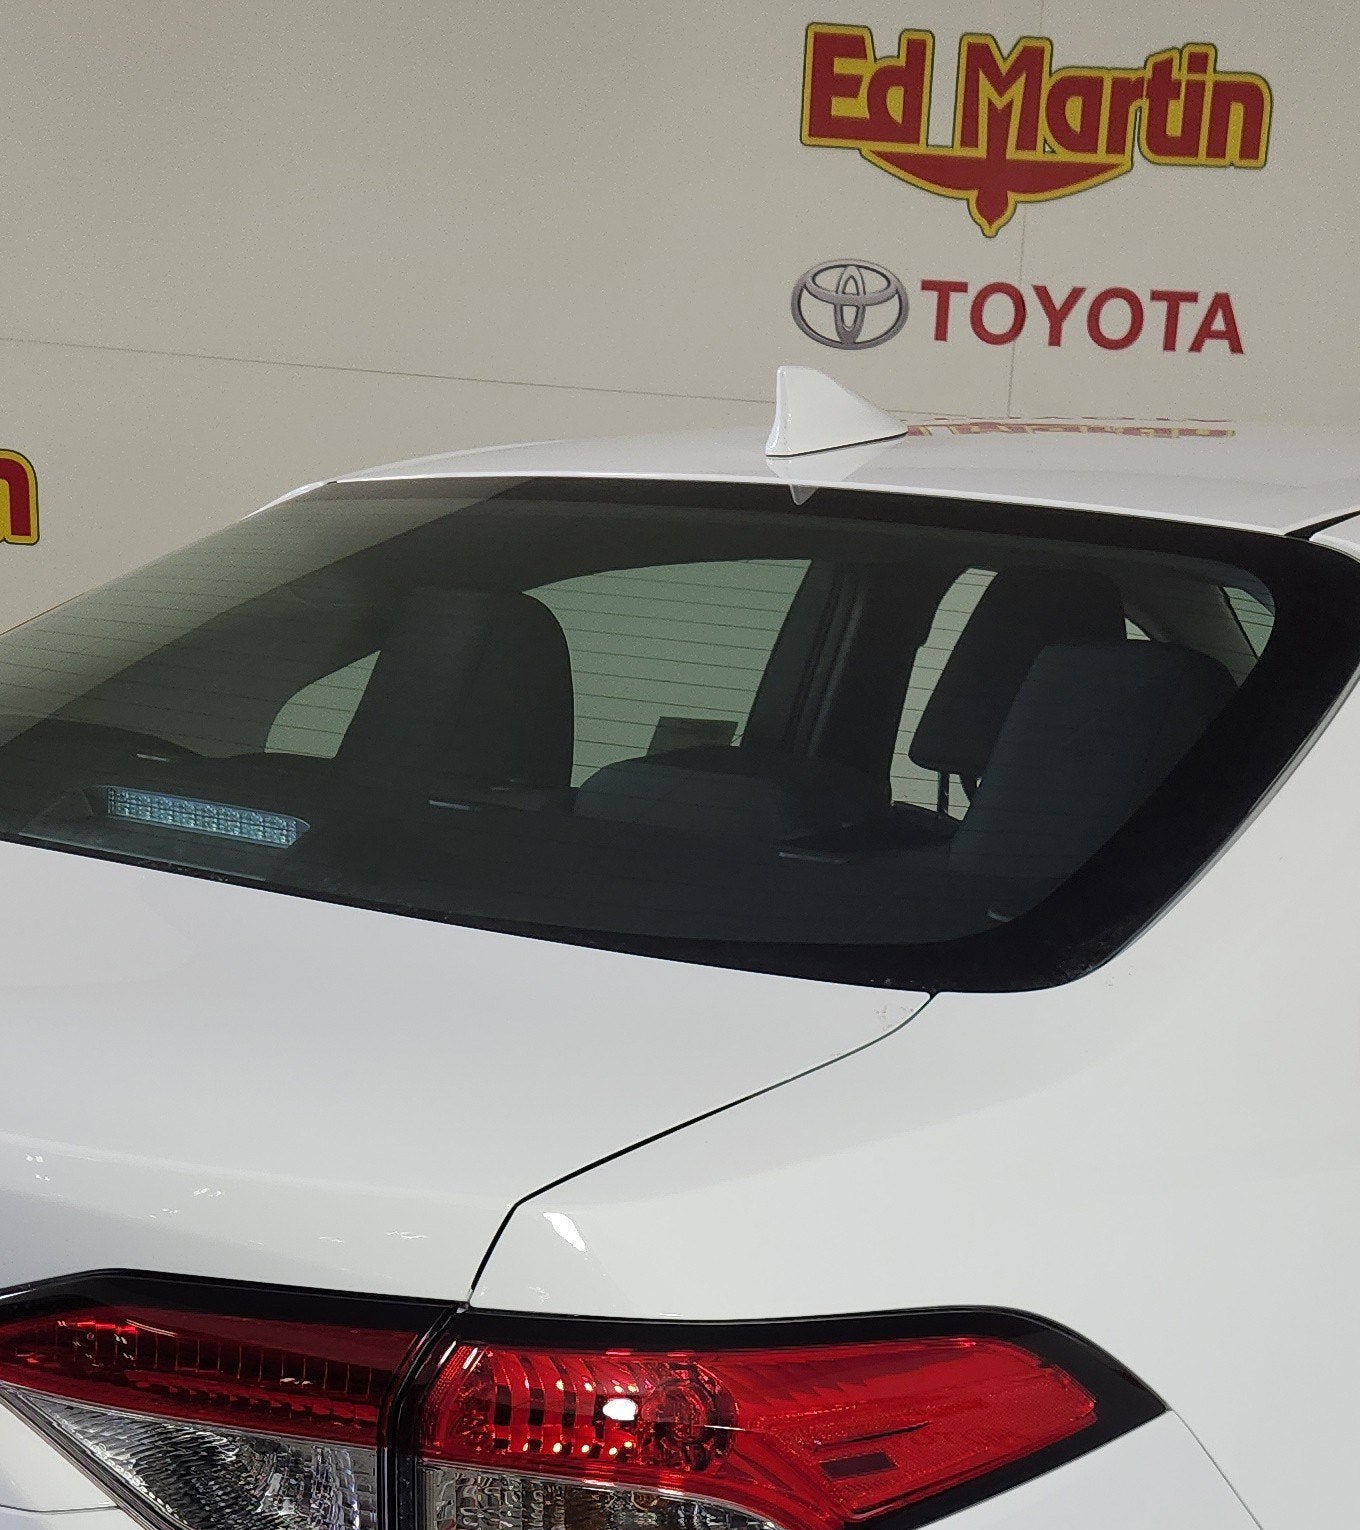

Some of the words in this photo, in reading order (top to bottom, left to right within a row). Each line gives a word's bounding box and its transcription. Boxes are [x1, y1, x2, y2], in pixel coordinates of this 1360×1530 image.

[802, 24, 932, 146] Ed
[960, 34, 1270, 166] Martin
[920, 279, 1245, 354] TOYOTA
